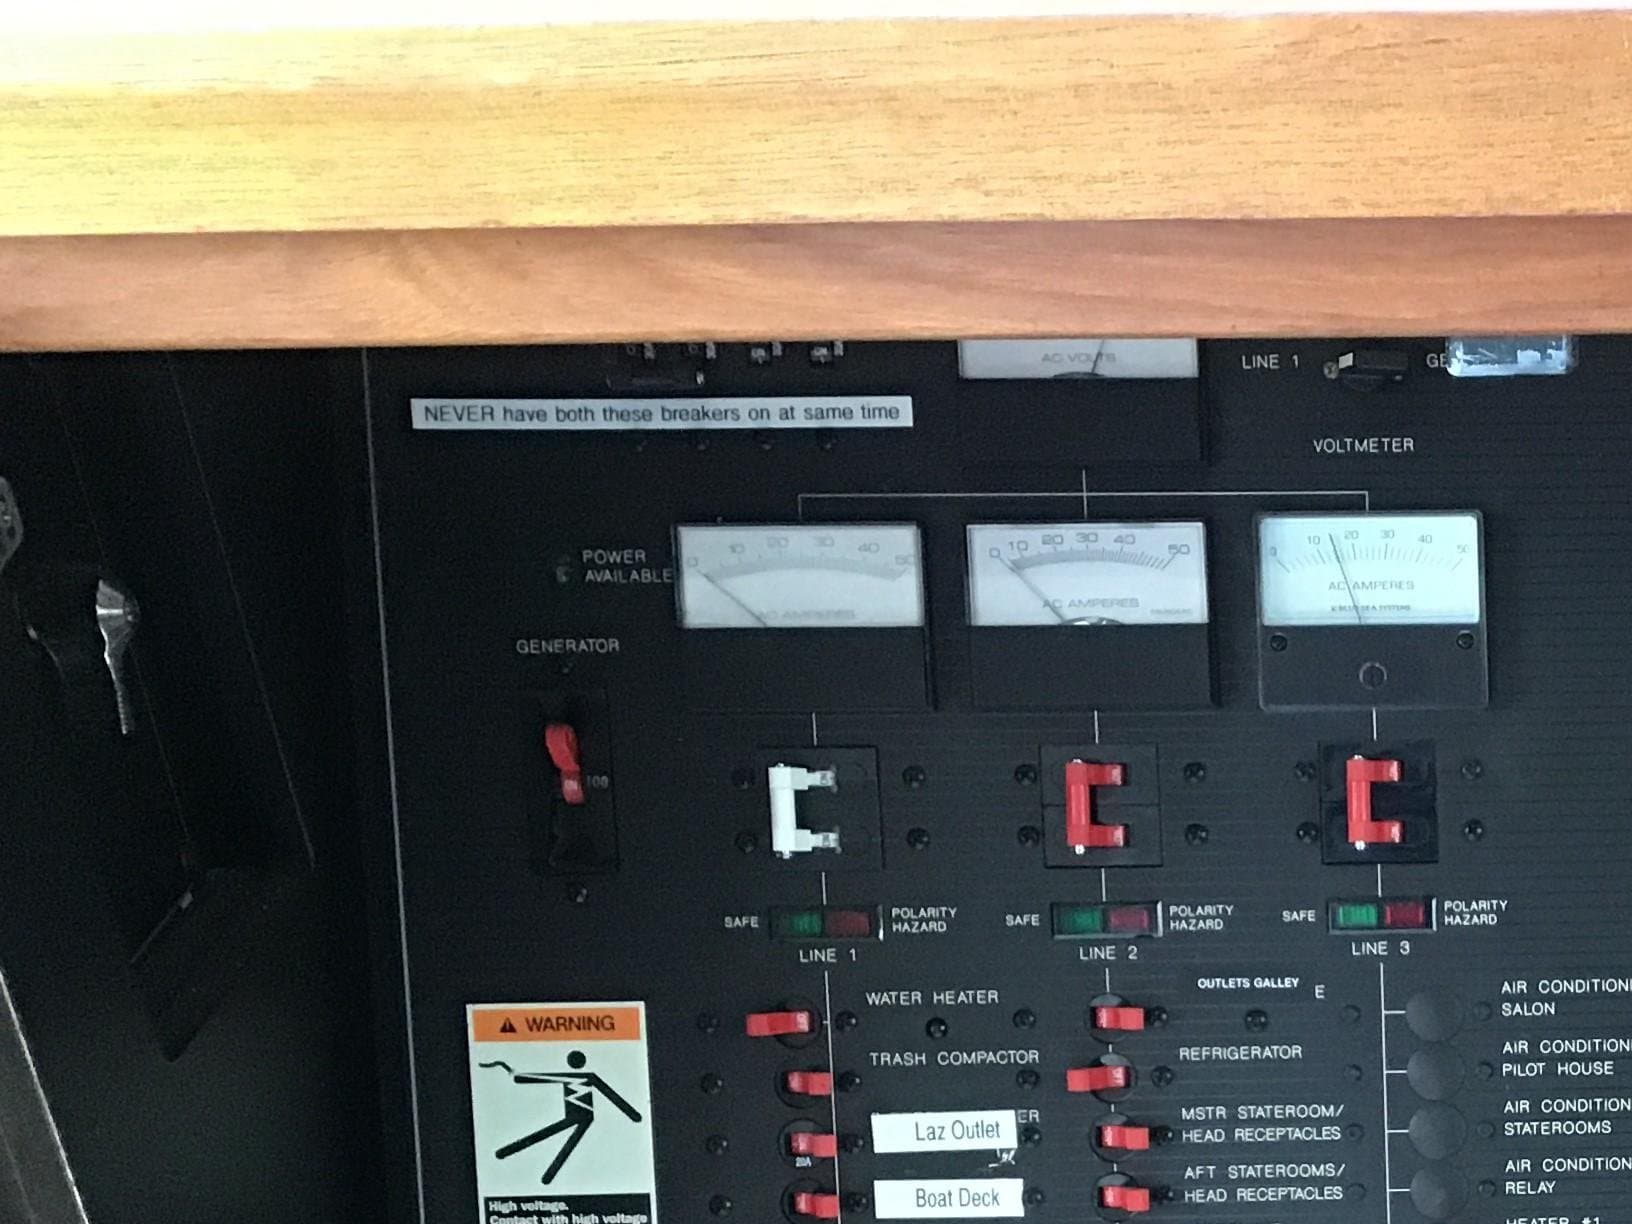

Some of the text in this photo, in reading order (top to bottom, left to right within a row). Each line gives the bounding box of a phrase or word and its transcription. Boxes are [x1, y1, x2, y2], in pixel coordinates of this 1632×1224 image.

[425, 404, 899, 422] NEVER have both these breakers on at same time
[1314, 438, 1413, 453] VOLTMETER
[583, 549, 646, 564] POWER
[586, 568, 671, 583] AVAILABLE
[517, 638, 619, 654] GENERATOR
[1445, 900, 1507, 912] POLARITY
[1283, 910, 1315, 922] SAFE
[1445, 914, 1497, 925] HAZARD
[1352, 941, 1410, 955] LINE 3
[1198, 977, 1299, 988] OUTLETS GALLEY
[1502, 981, 1527, 993] AIR
[866, 990, 998, 1005] WATER HEATER
[1502, 1002, 1555, 1016] SALON
[525, 1015, 615, 1032] WARNING
[1180, 1045, 1302, 1060] REFRIGERATOR
[1503, 1040, 1528, 1054] AIR
[870, 1050, 1039, 1066] TRASH COMPACTOR
[1503, 1061, 1613, 1076] PILOT HOUSE
[1182, 1104, 1344, 1120] MSTR STATEROOM/
[915, 1120, 1000, 1141] Laz Outlet
[1183, 1126, 1341, 1142] HEAD RECEPTACLES
[916, 1188, 1000, 1208] Boat Deck
